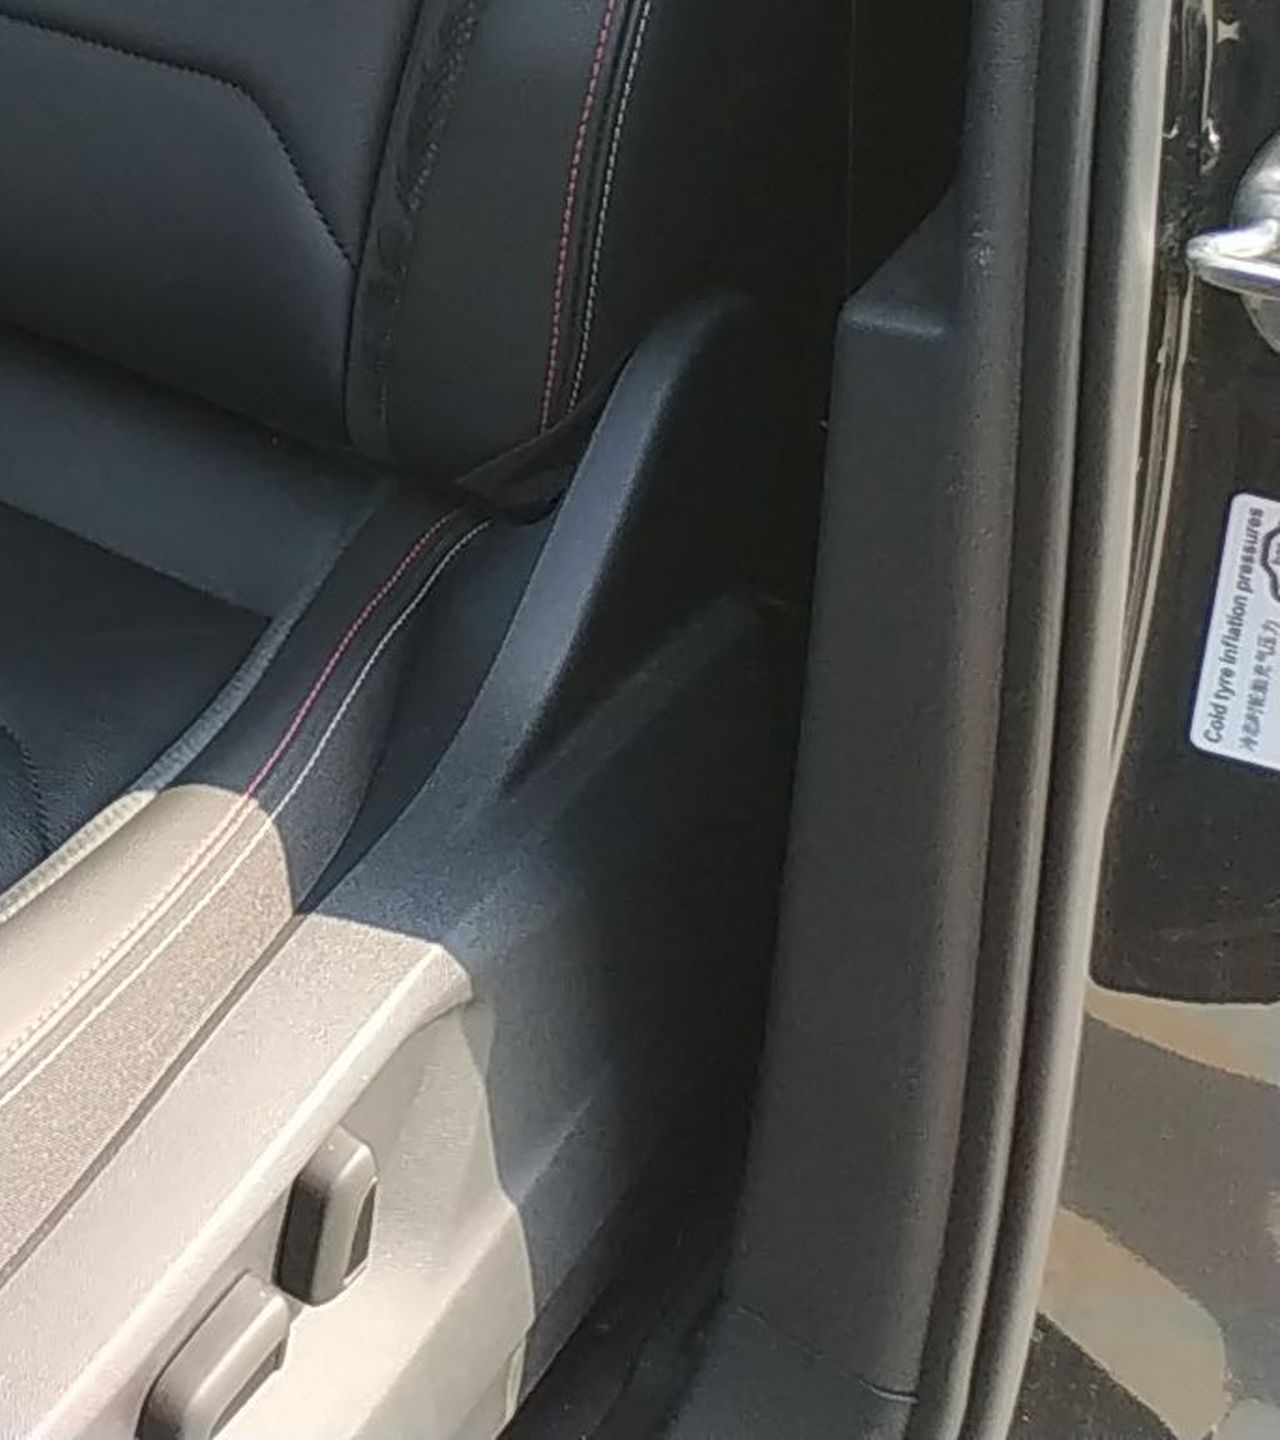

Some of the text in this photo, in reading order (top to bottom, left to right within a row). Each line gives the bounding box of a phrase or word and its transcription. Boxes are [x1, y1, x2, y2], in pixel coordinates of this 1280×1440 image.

[1203, 508, 1264, 743] Cold tyre inflation pressures
